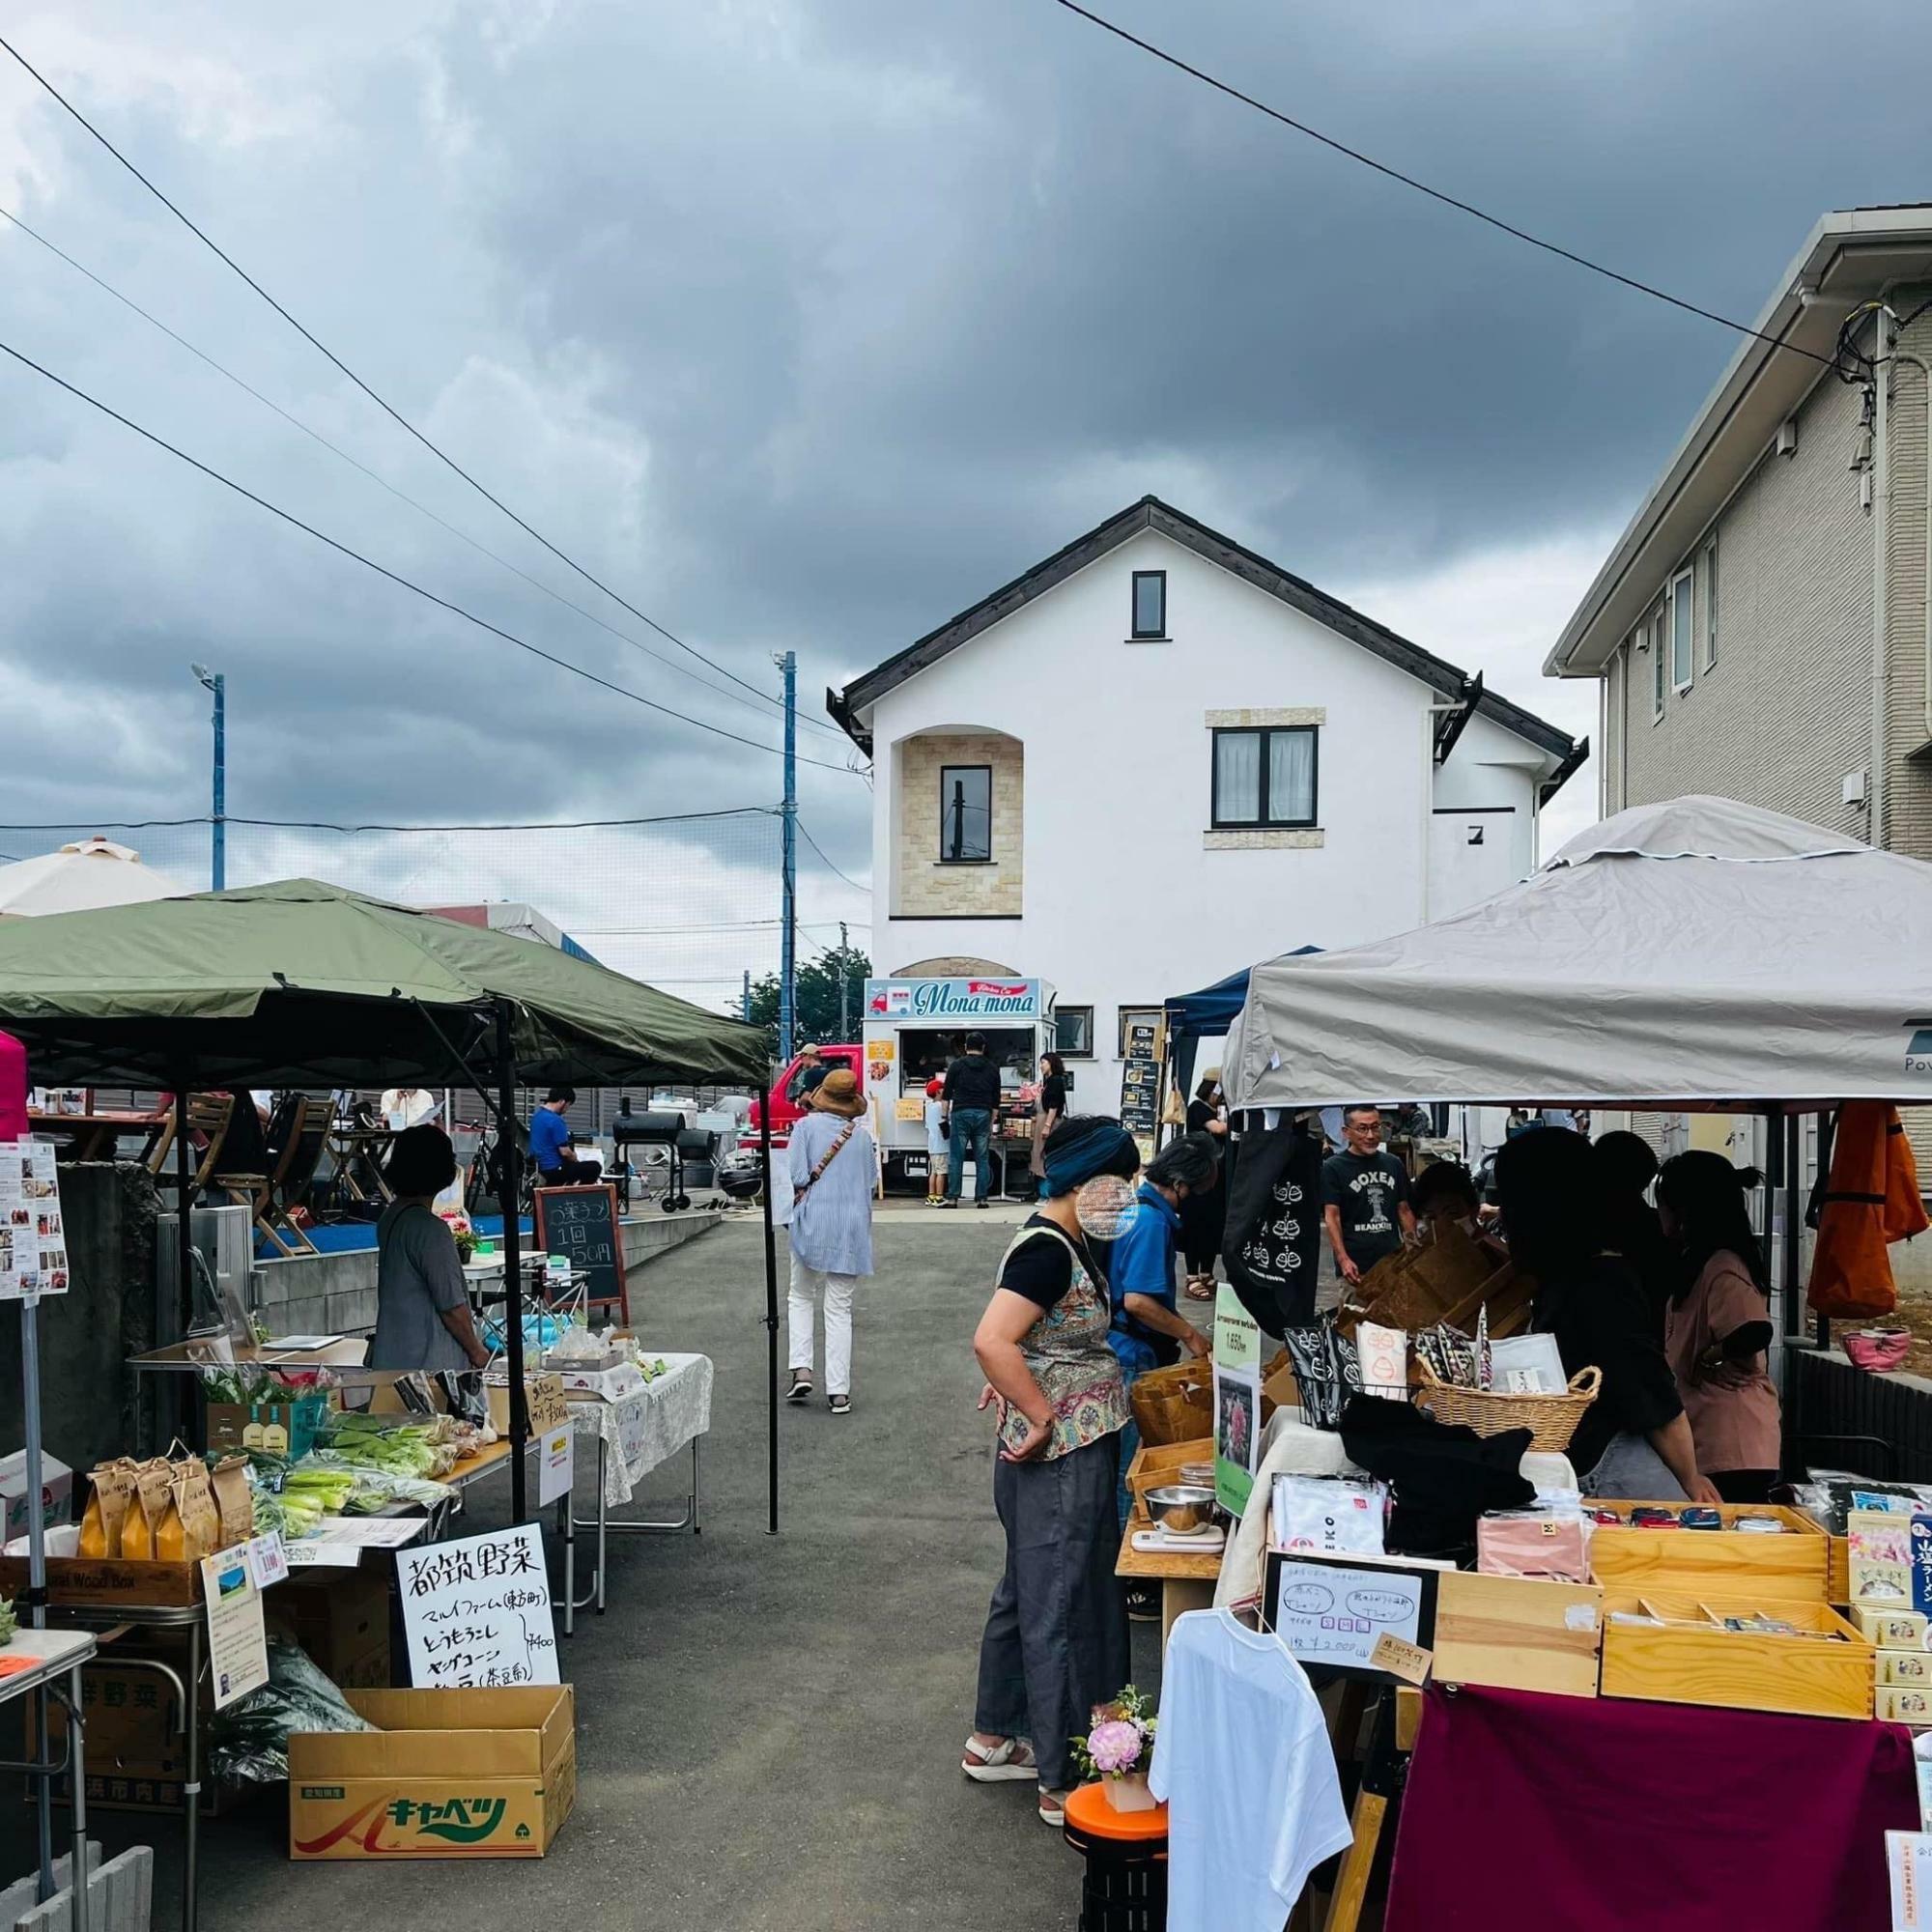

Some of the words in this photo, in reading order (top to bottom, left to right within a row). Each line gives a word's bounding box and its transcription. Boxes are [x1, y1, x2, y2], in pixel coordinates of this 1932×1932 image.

[1349, 1171, 1396, 1193] BOXER
[556, 1225, 586, 1246] 1回
[571, 1243, 611, 1264] 50円
[408, 1536, 542, 1597] 都筑野菜
[422, 1625, 499, 1653] とうもろこし
[427, 1650, 501, 1675] ヤングコーン
[387, 1799, 507, 1843] キャベツ
